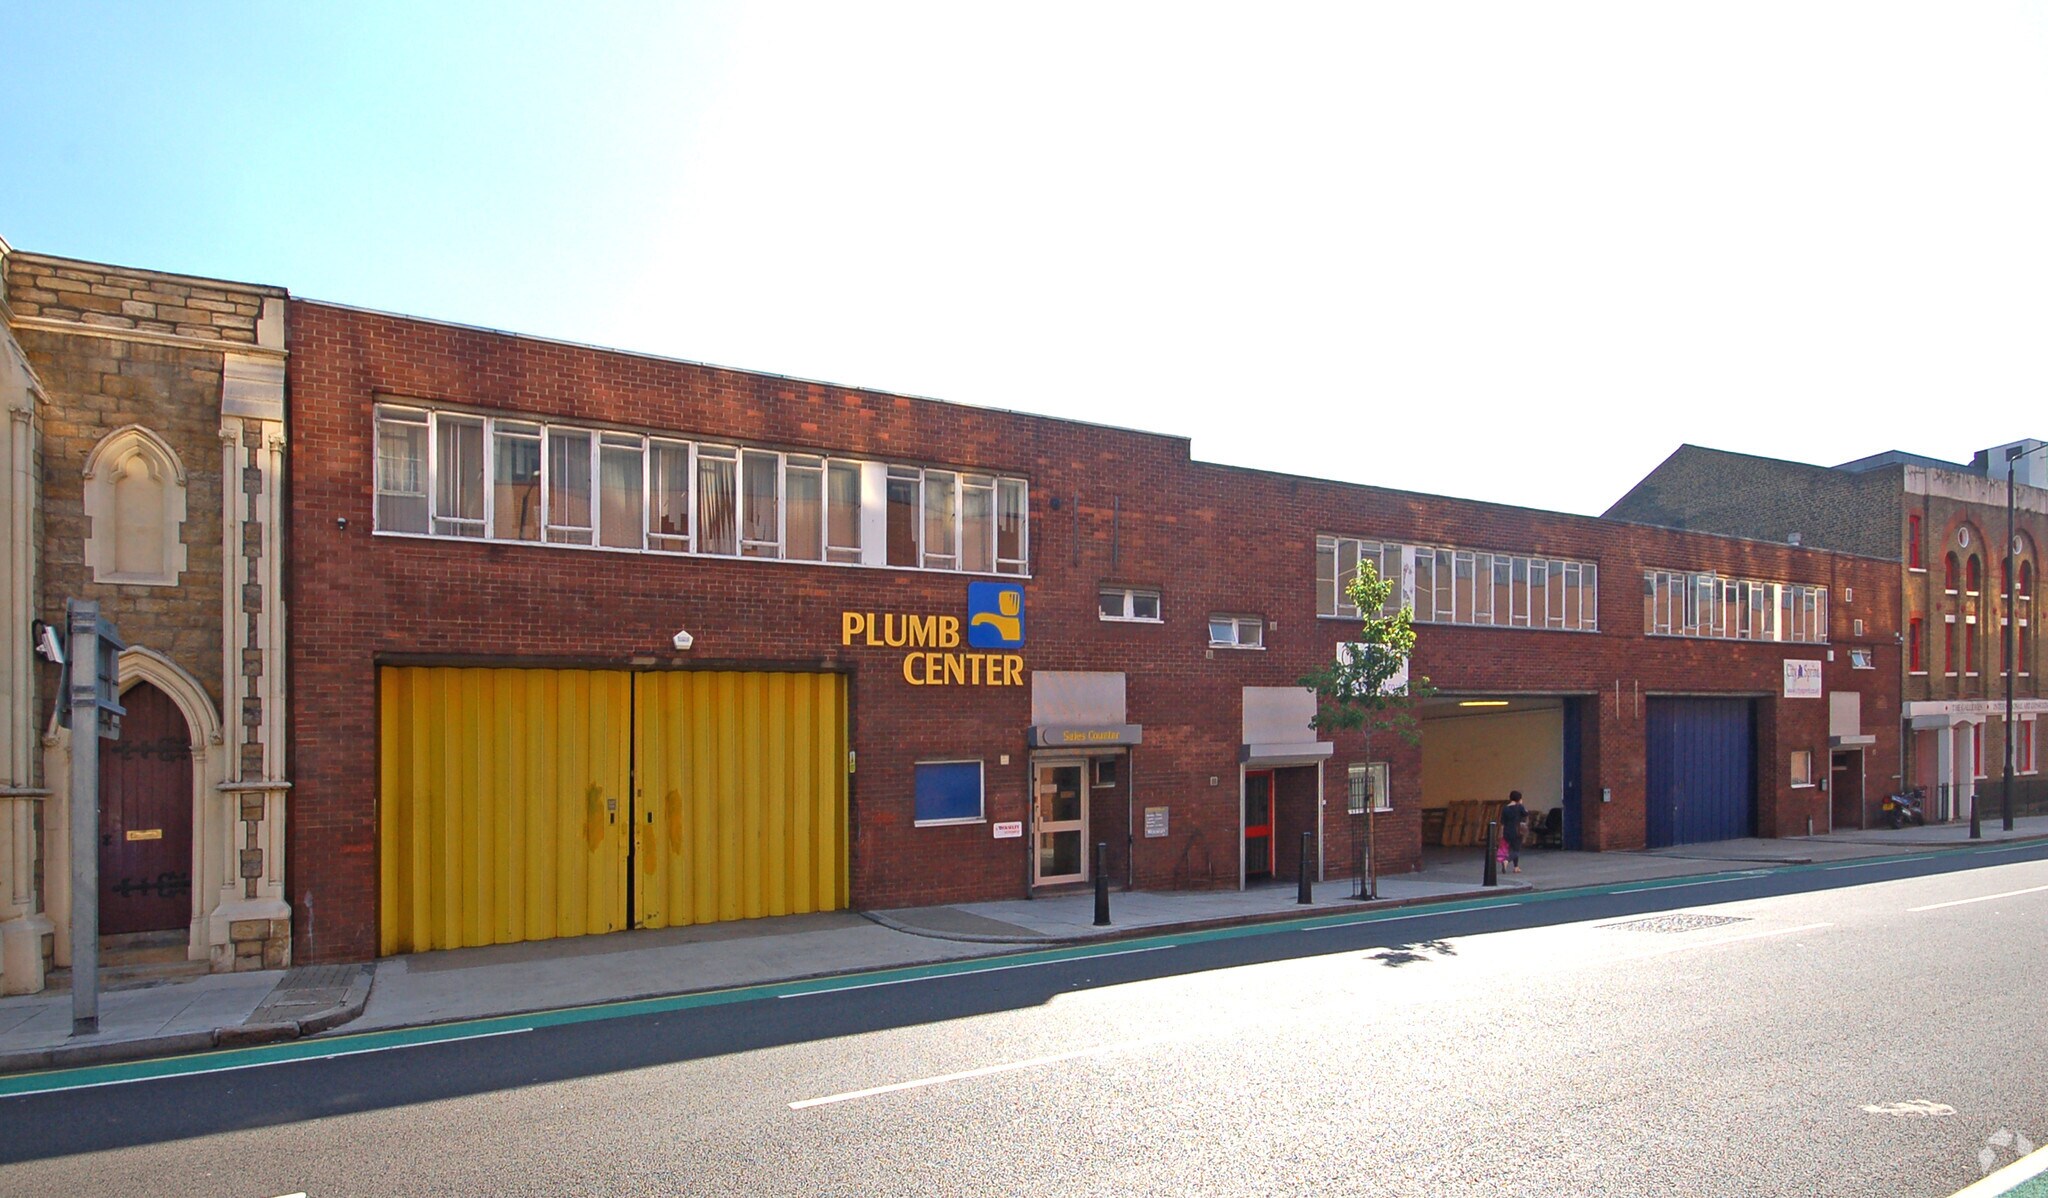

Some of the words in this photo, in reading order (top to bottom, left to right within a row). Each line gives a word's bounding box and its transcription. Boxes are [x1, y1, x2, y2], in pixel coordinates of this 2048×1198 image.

[842, 612, 960, 648] PLUMB
[903, 651, 1024, 686] CENTER
[1063, 730, 1086, 742] Sales
[1088, 730, 1120, 742] Counter
